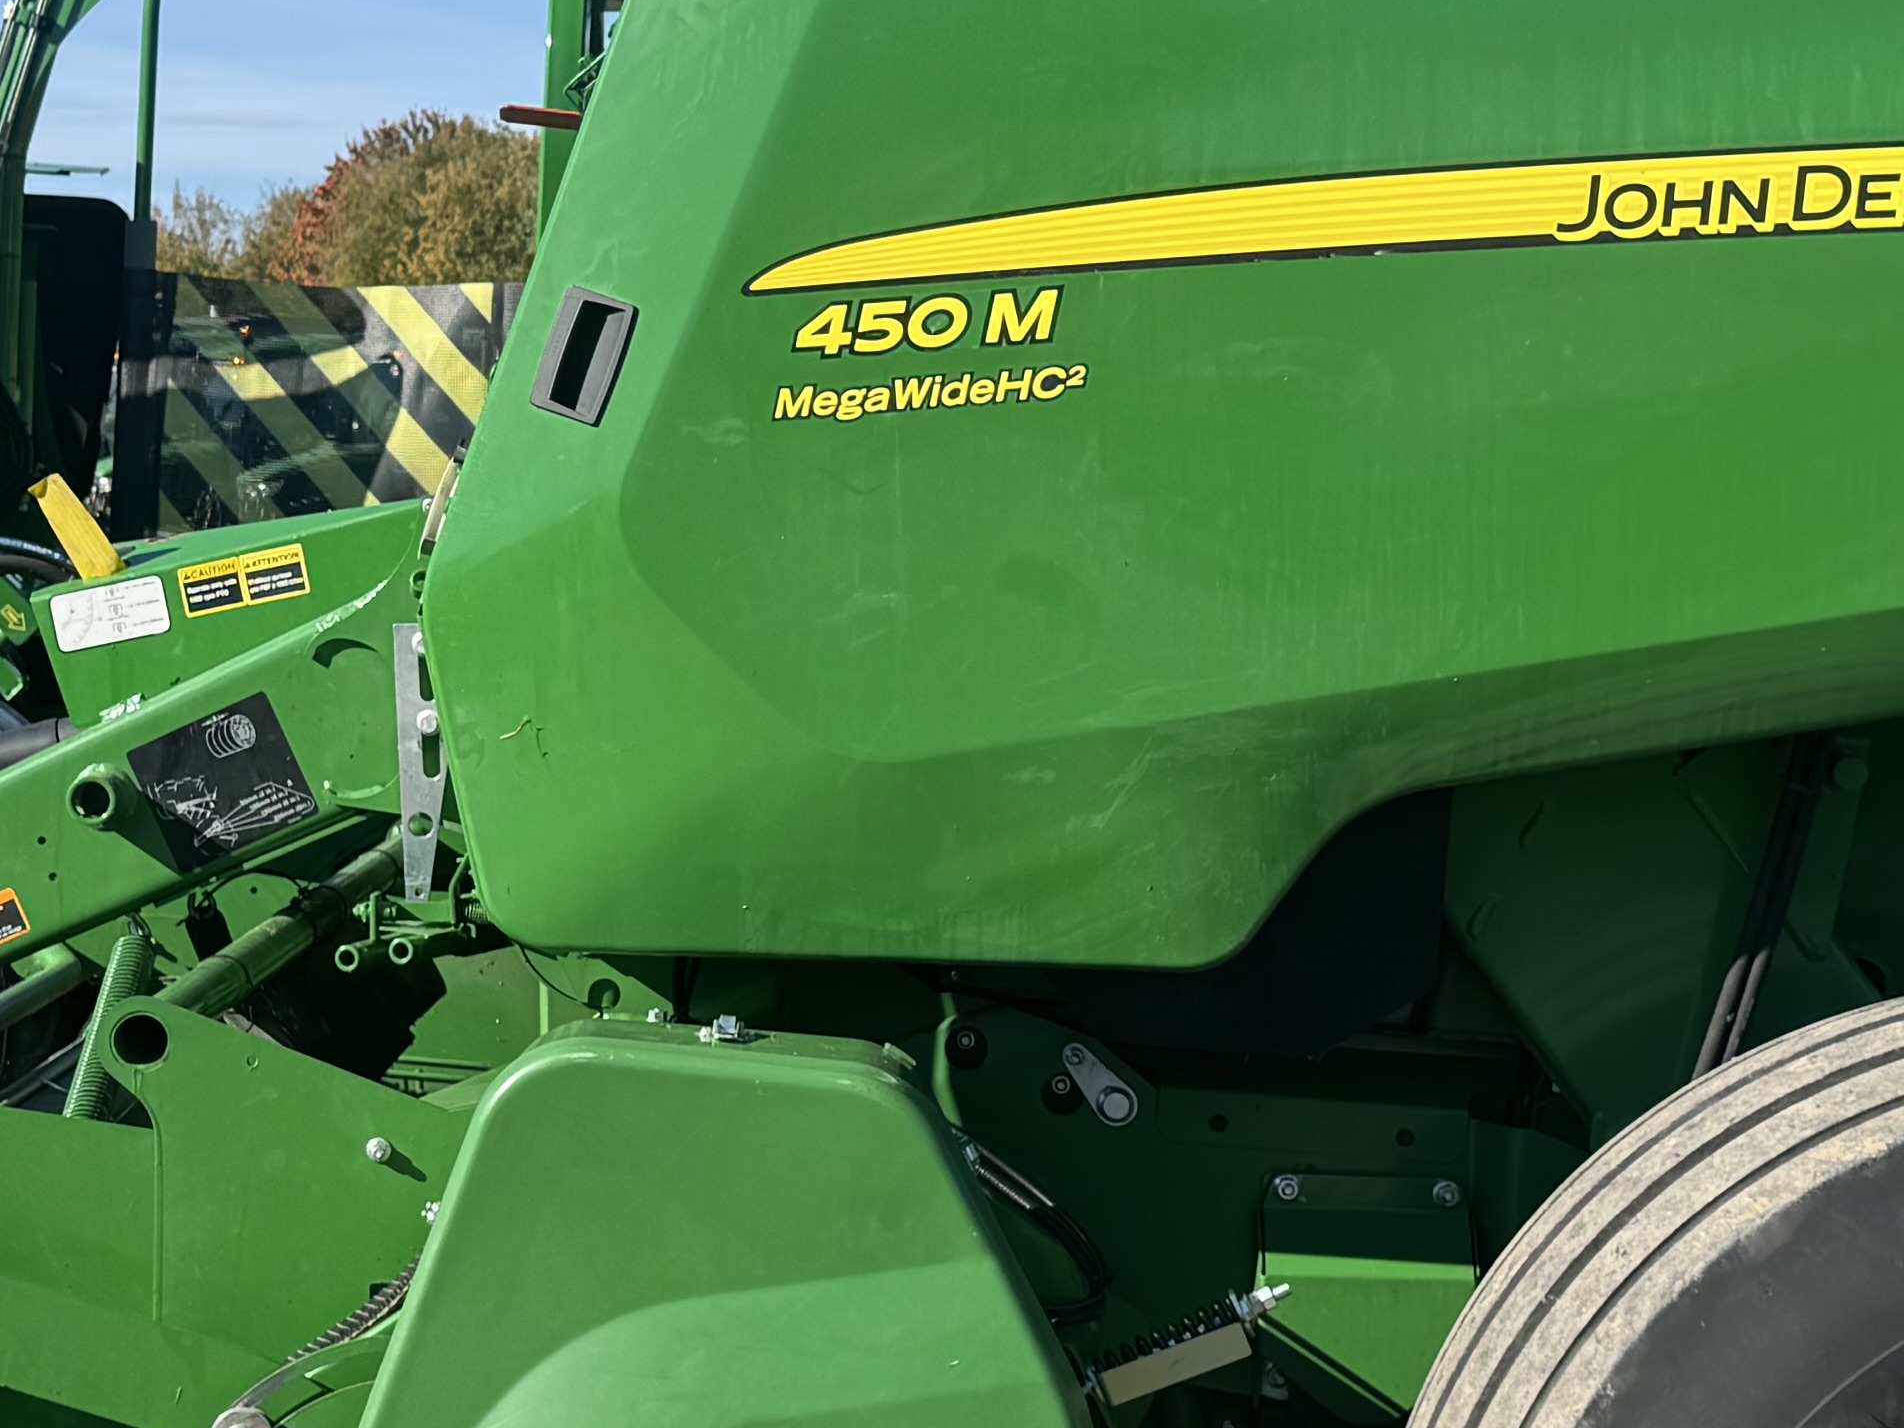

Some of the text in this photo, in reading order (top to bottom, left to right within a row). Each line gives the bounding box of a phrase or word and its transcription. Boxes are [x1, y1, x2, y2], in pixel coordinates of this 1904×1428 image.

[1556, 174, 1771, 232] JOHN
[794, 287, 1061, 356] 450 M
